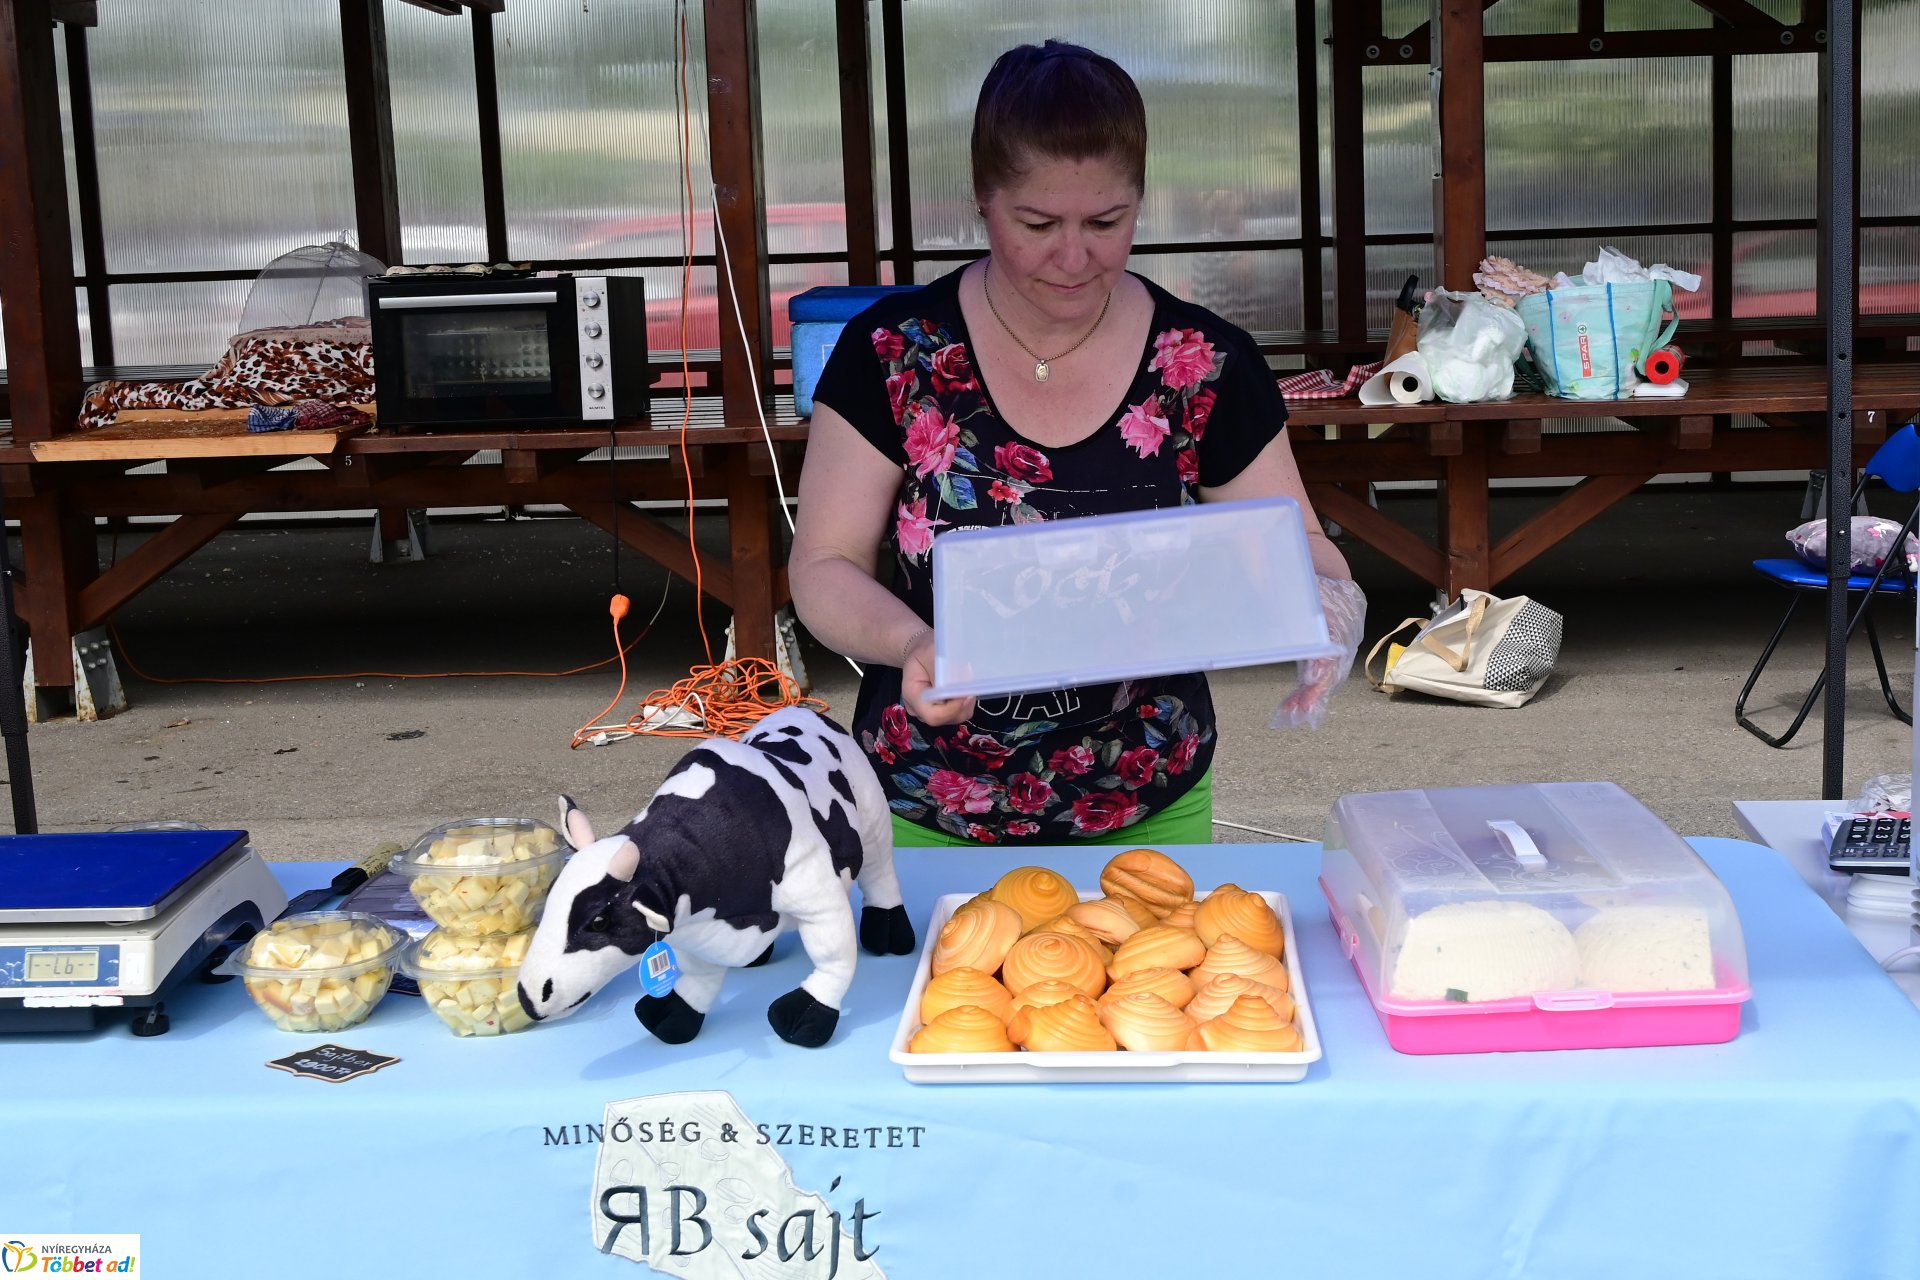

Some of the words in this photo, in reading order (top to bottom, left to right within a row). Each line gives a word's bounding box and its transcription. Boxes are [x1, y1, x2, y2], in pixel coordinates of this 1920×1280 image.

[1580, 336, 1590, 370] SPAR
[1867, 410, 1875, 423] 7
[345, 455, 352, 466] 5
[543, 1117, 702, 1146] MINŐSÉG
[720, 1122, 739, 1143] &
[755, 1123, 926, 1148] SZERETET
[741, 1175, 882, 1280] sajt
